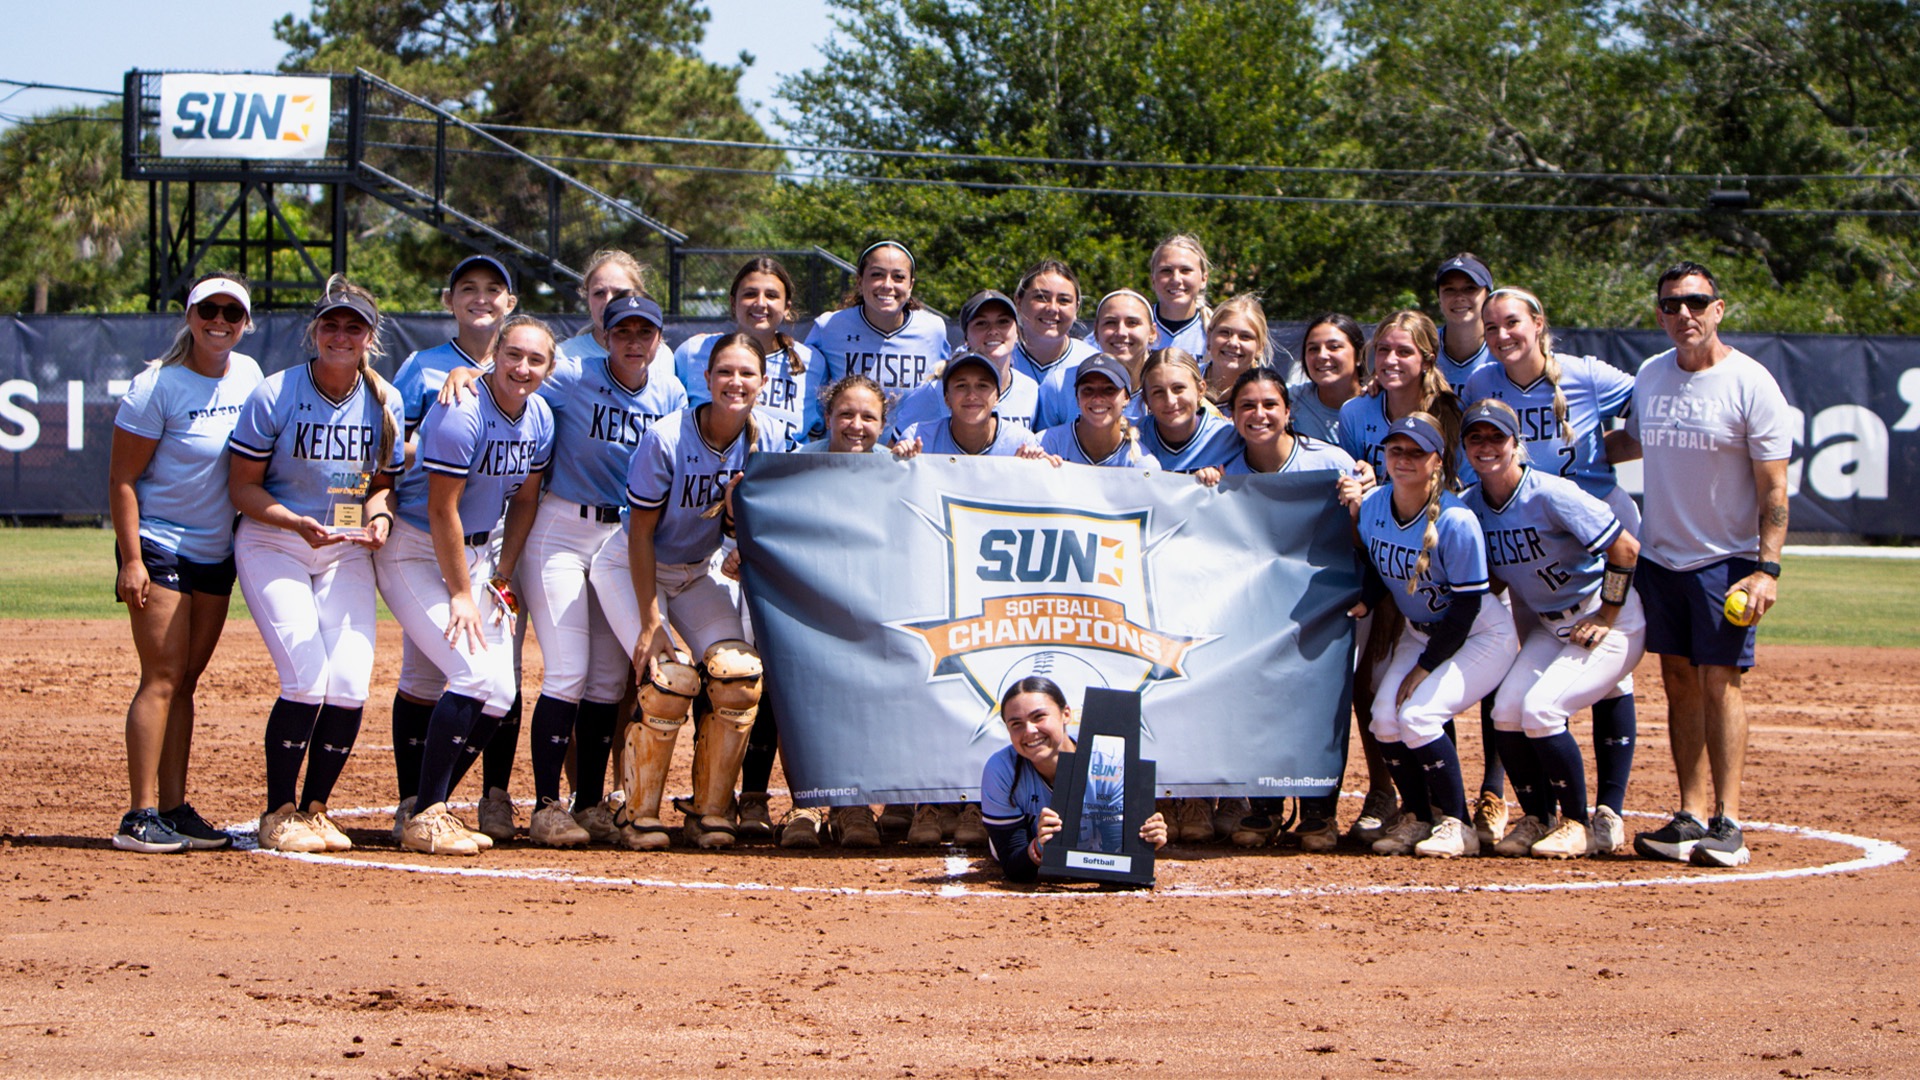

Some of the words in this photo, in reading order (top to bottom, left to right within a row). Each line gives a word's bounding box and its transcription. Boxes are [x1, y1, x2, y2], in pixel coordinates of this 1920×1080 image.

[172, 91, 286, 140] SUN
[845, 352, 926, 388] KEISER
[0, 379, 131, 452] SI
[1645, 395, 1720, 423] KEISER
[293, 421, 374, 461] KEISER
[477, 439, 537, 476] KEISER
[1640, 428, 1719, 451] SOFTBALL
[1558, 446, 1577, 477] 2
[975, 529, 1098, 583] SUN
[1484, 526, 1547, 567] EISER
[1536, 561, 1572, 592] 16
[1005, 598, 1104, 618] SOFTBALL
[948, 616, 1162, 661] CHAMPIONS
[1090, 764, 1116, 776] SUN
[1083, 856, 1115, 867] Softball
